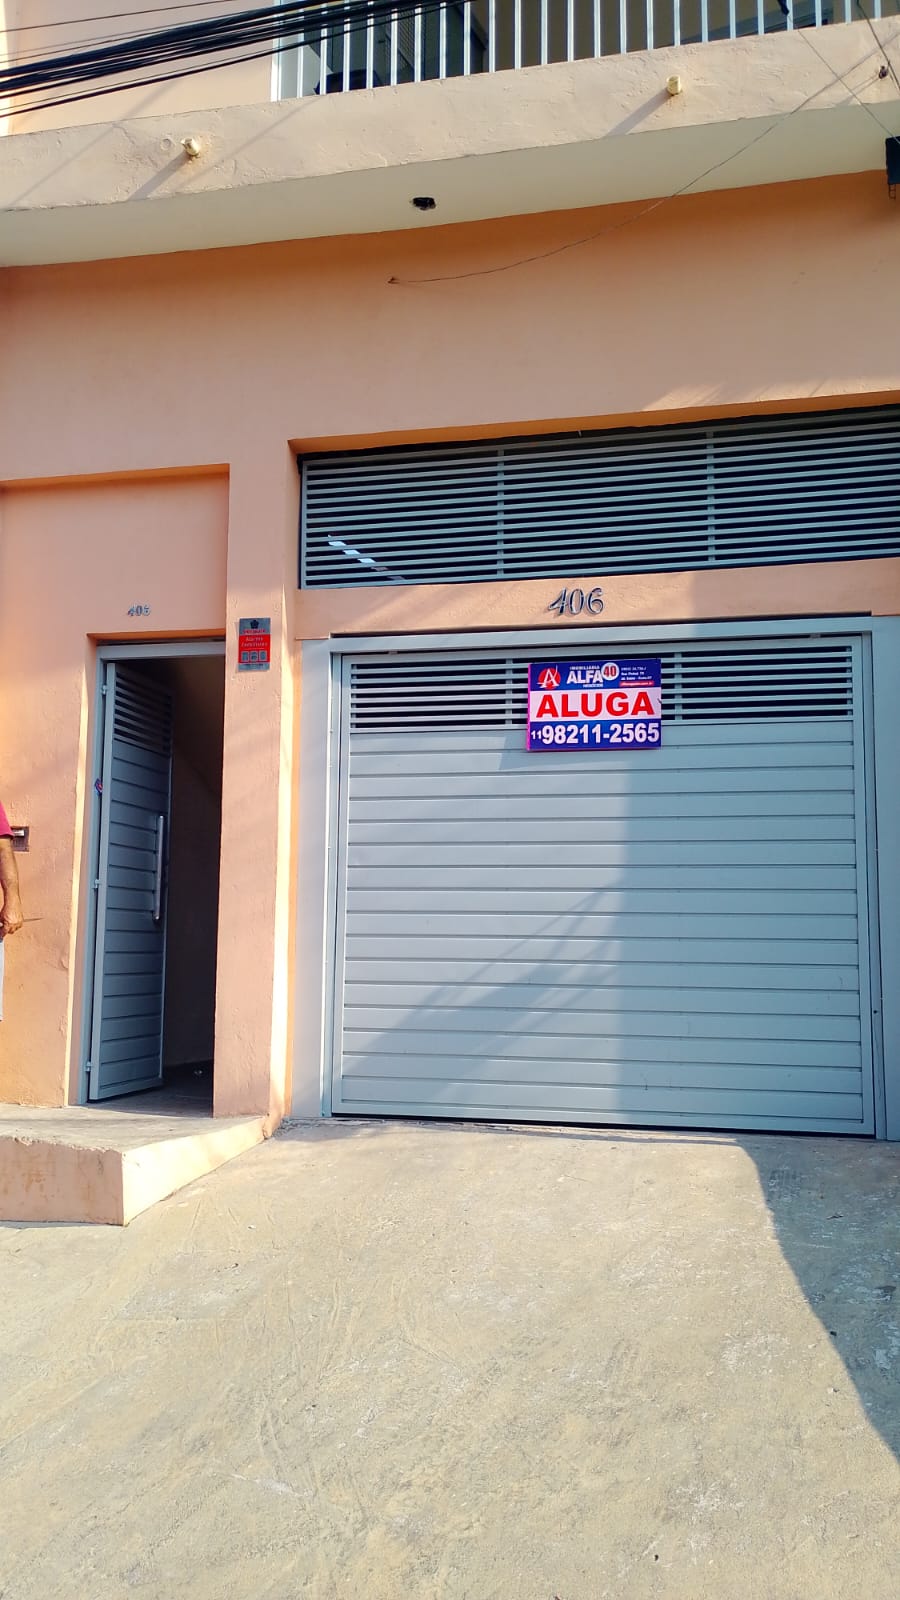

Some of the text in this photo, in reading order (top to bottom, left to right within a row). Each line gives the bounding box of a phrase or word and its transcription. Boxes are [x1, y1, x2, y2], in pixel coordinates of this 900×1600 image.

[548, 587, 604, 615] 406
[566, 669, 604, 685] ALFA
[603, 665, 617, 678] 40
[536, 691, 655, 718] ALUGA
[542, 722, 660, 745] 98211-2565
